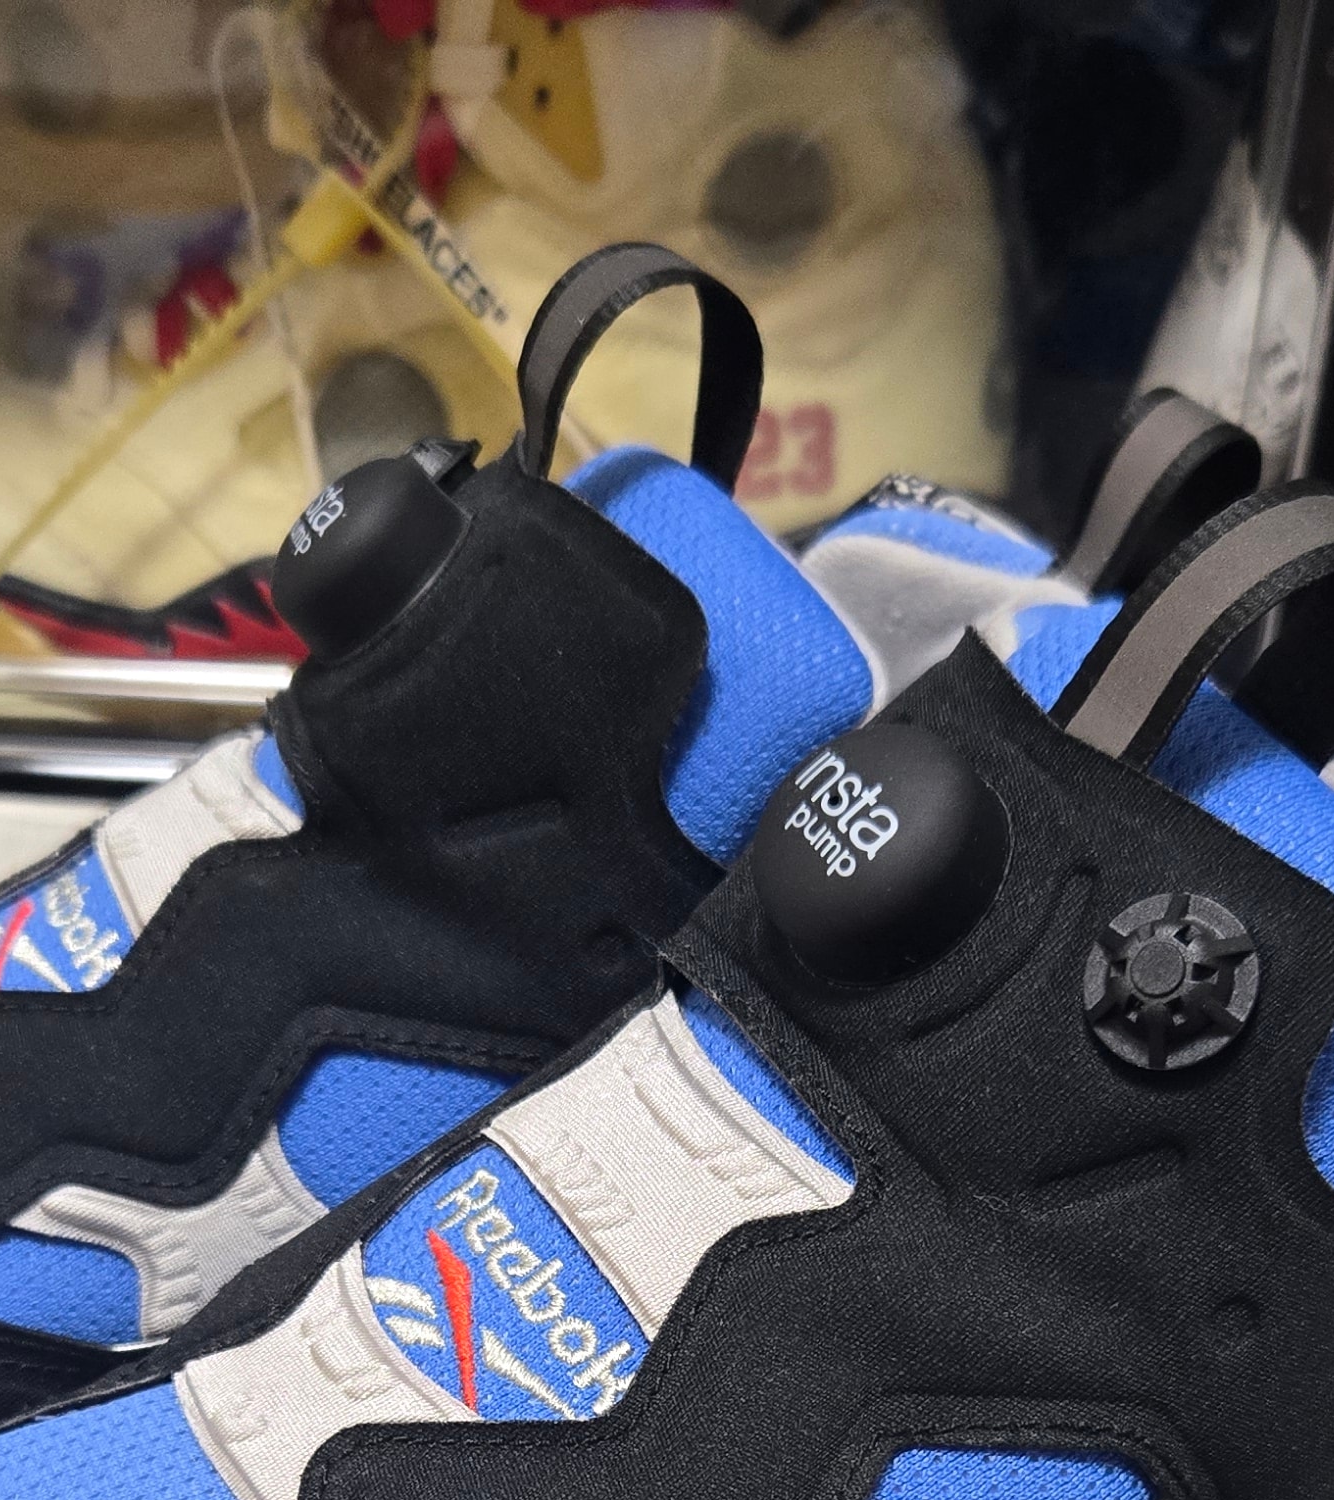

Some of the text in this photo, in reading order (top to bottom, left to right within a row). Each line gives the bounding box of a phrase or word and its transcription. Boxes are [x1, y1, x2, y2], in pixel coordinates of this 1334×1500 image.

[731, 401, 837, 499] 23
[784, 802, 857, 878] pump
[794, 750, 899, 861] insta
[436, 1168, 635, 1416] Reebok
